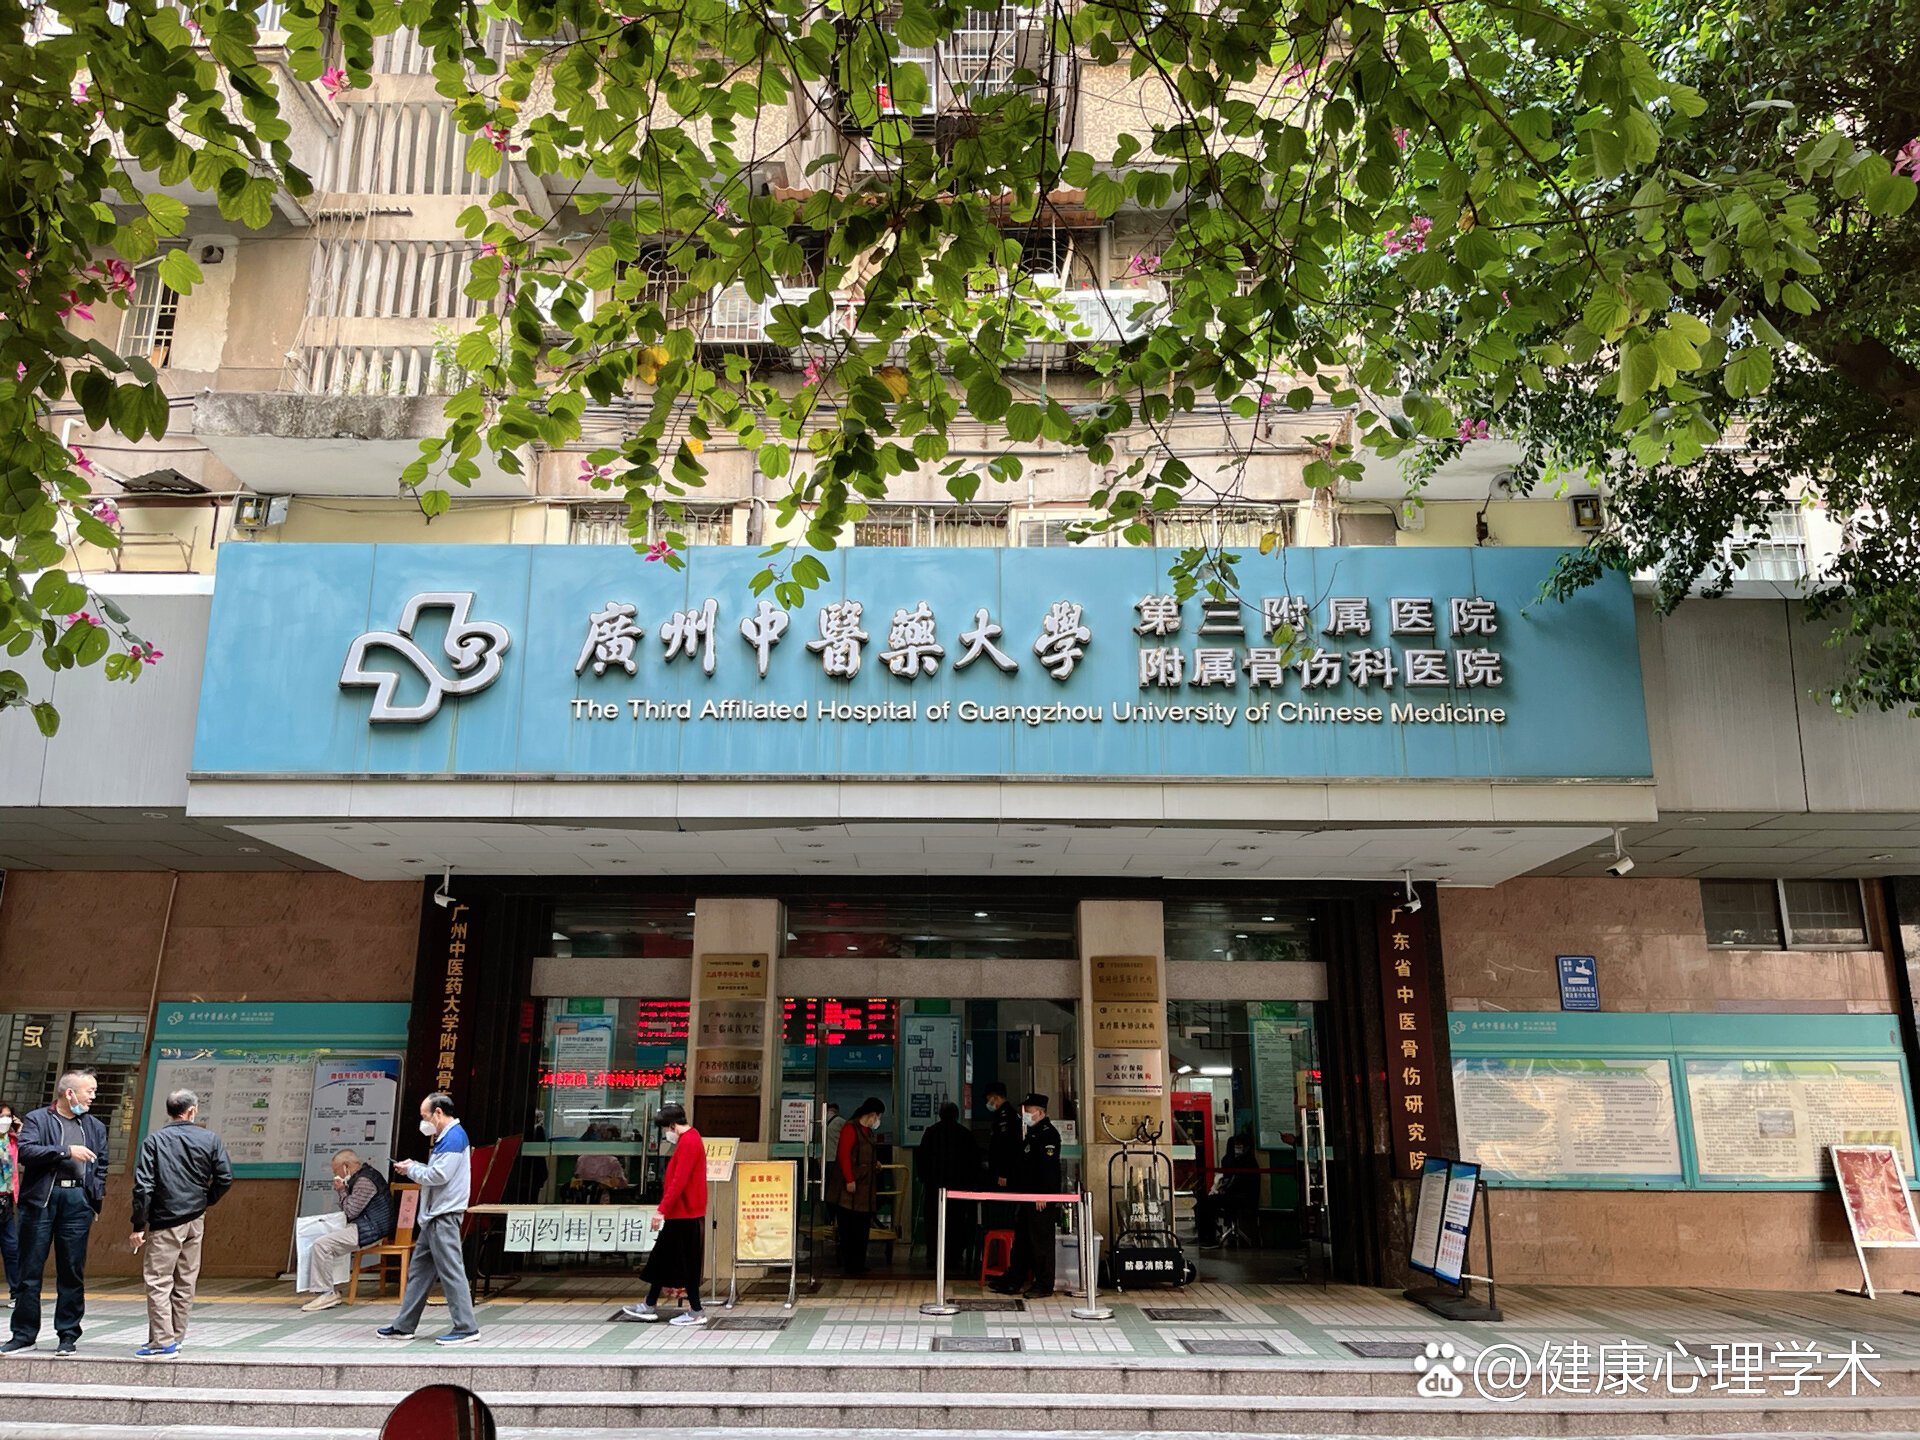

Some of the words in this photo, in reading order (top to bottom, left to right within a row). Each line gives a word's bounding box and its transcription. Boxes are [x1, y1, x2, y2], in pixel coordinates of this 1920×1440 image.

[1133, 593, 1498, 638] 第三附属医院
[574, 599, 1092, 680] 廣州中醫藥大學
[1138, 647, 1504, 690] 附属骨伤科医院
[571, 699, 619, 720] The
[628, 699, 691, 720] Third
[700, 699, 808, 721] Affiliated
[818, 699, 918, 724] Hospital
[927, 700, 951, 721] of
[958, 700, 1103, 725] Guangzhou
[1112, 702, 1237, 725] University
[1245, 702, 1270, 722] of
[1277, 702, 1383, 722] Chinese
[1391, 702, 1506, 723] Medicine
[436, 903, 470, 1096] 广州中医药大学附属骨
[1390, 908, 1428, 1170] 广东省中医骨伤研究院
[802, 1053, 808, 1061] 2
[877, 1053, 882, 1061] 1
[509, 1217, 659, 1243] 预约挂号指
[1125, 1260, 1174, 1270] 防暴消防架
